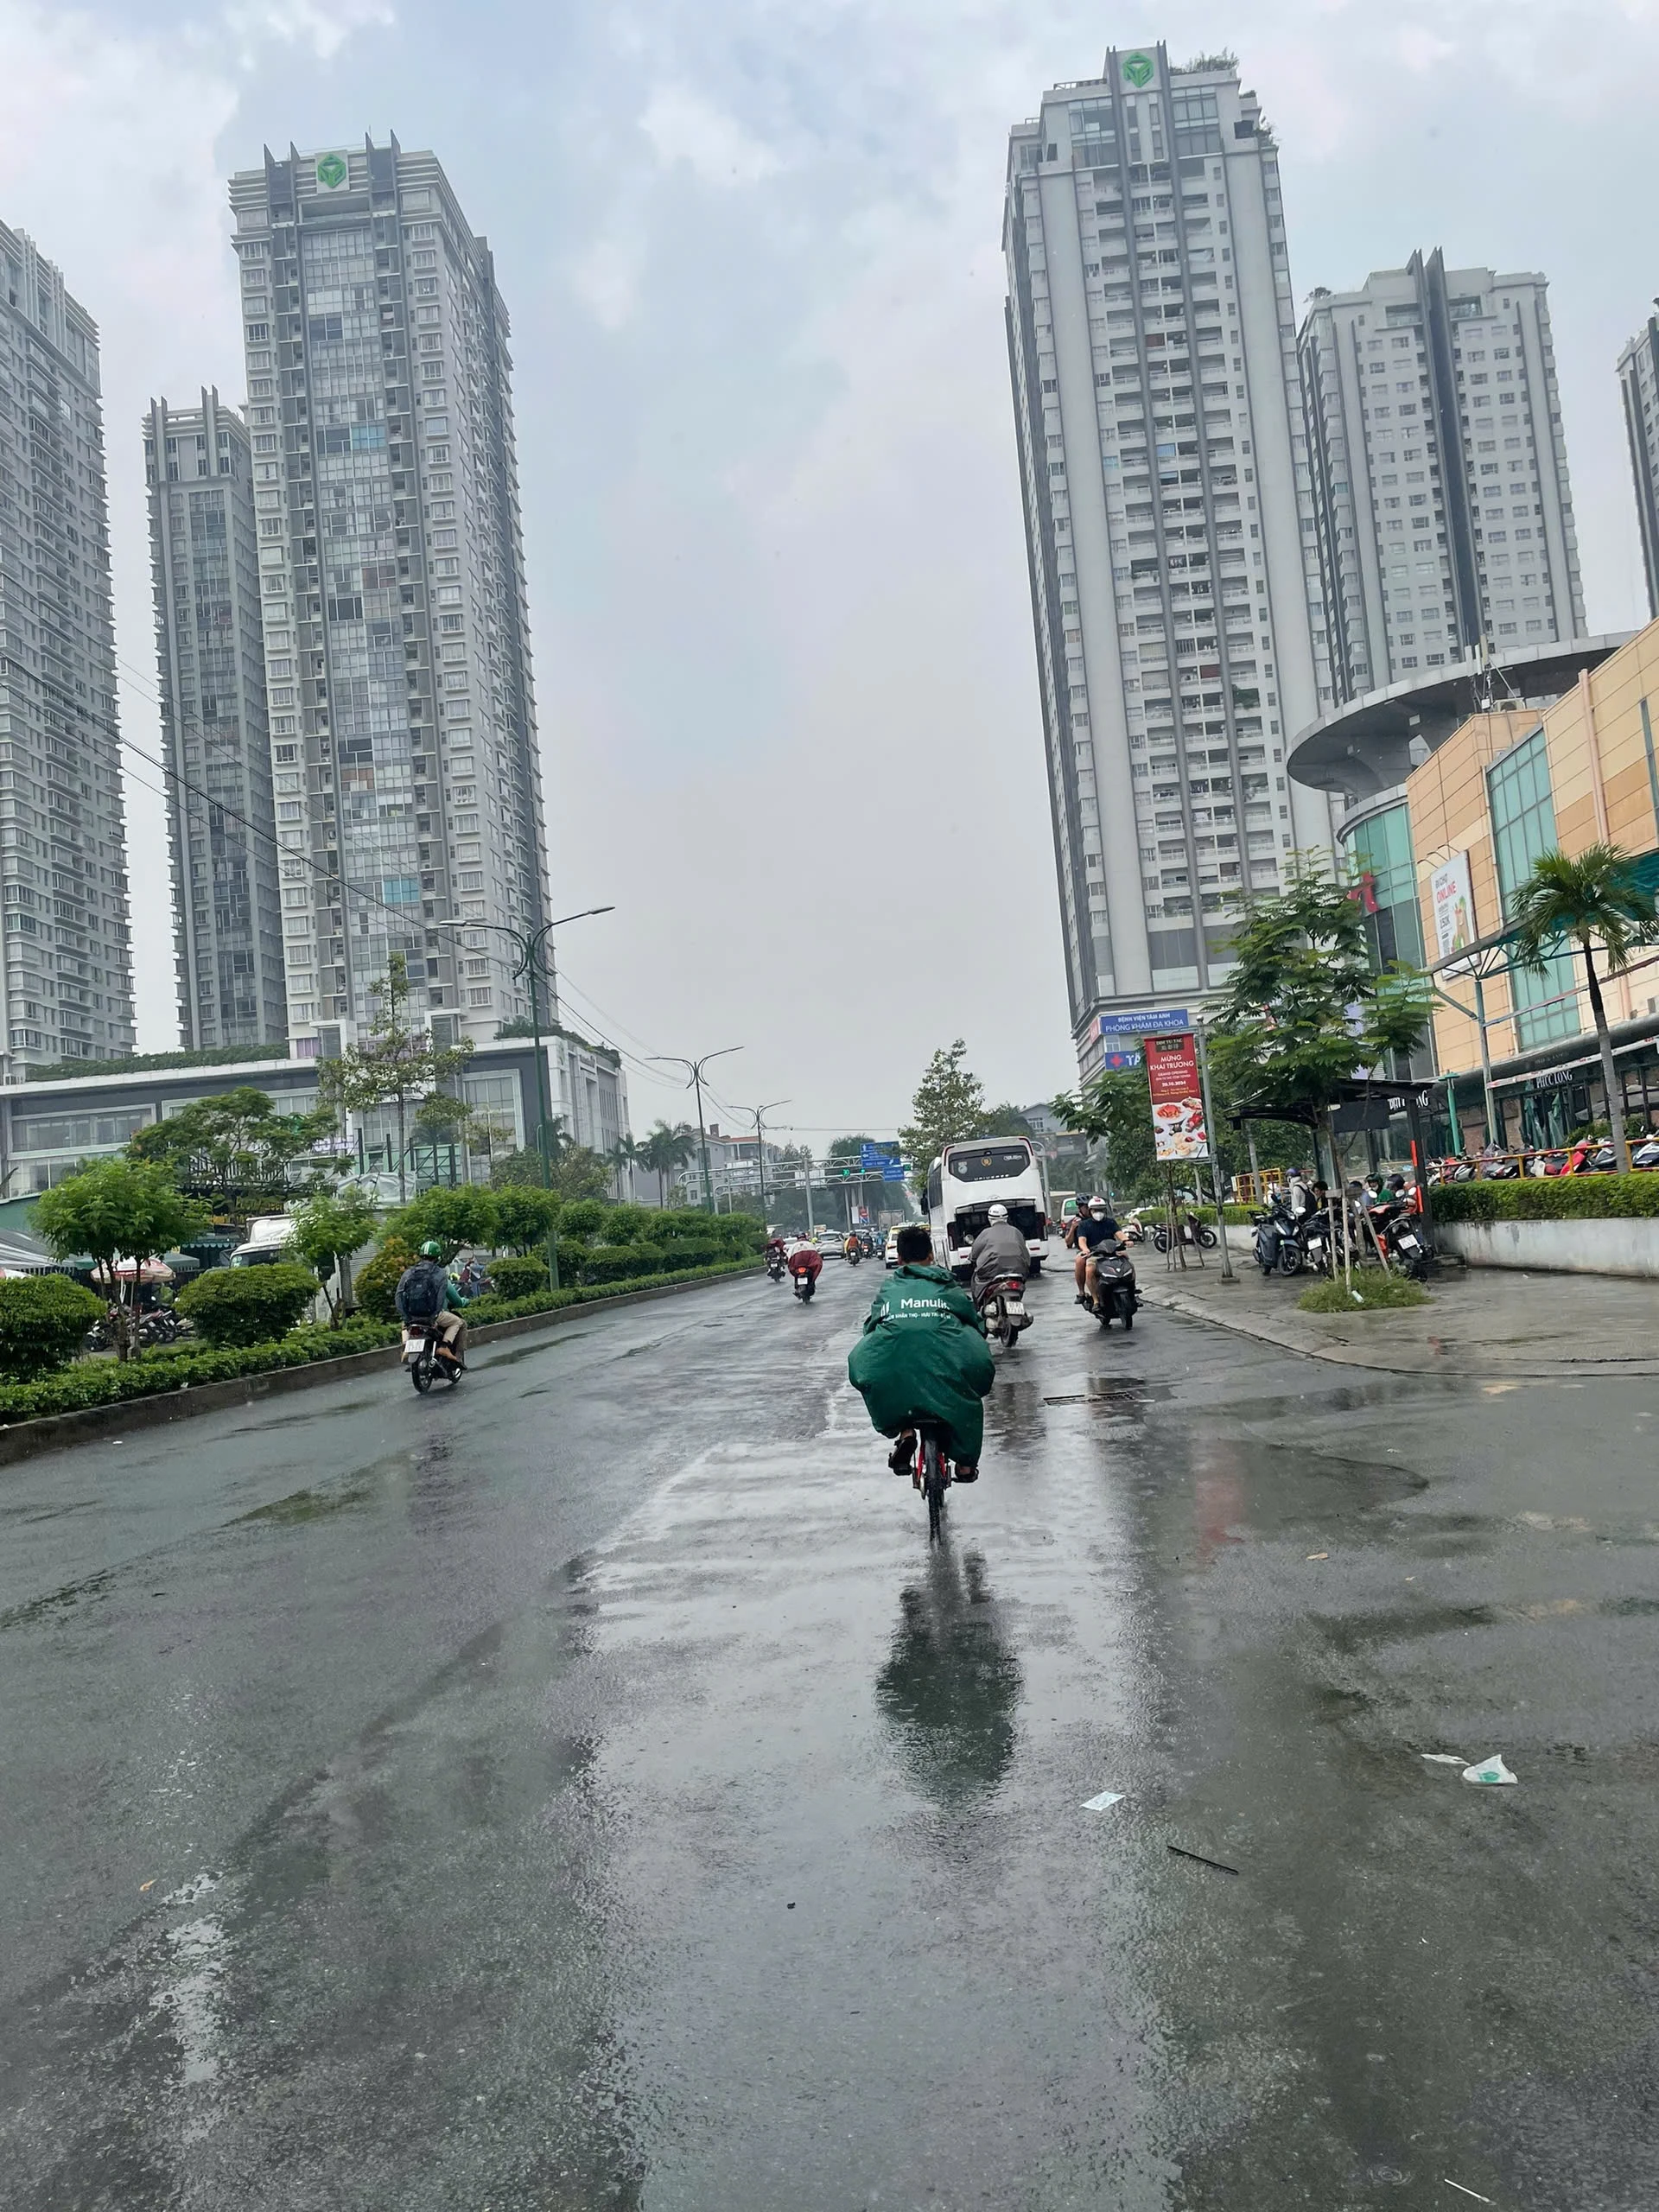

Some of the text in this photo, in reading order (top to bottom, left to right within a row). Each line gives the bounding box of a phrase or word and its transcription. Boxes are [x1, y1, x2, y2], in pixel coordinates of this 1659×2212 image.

[1437, 881, 1457, 903] ONLINE
[1164, 1019, 1184, 1027] KHOA
[1126, 1052, 1141, 1065] TÂ
[1554, 1070, 1573, 1084] LONG
[900, 1298, 950, 1310] Manuli
